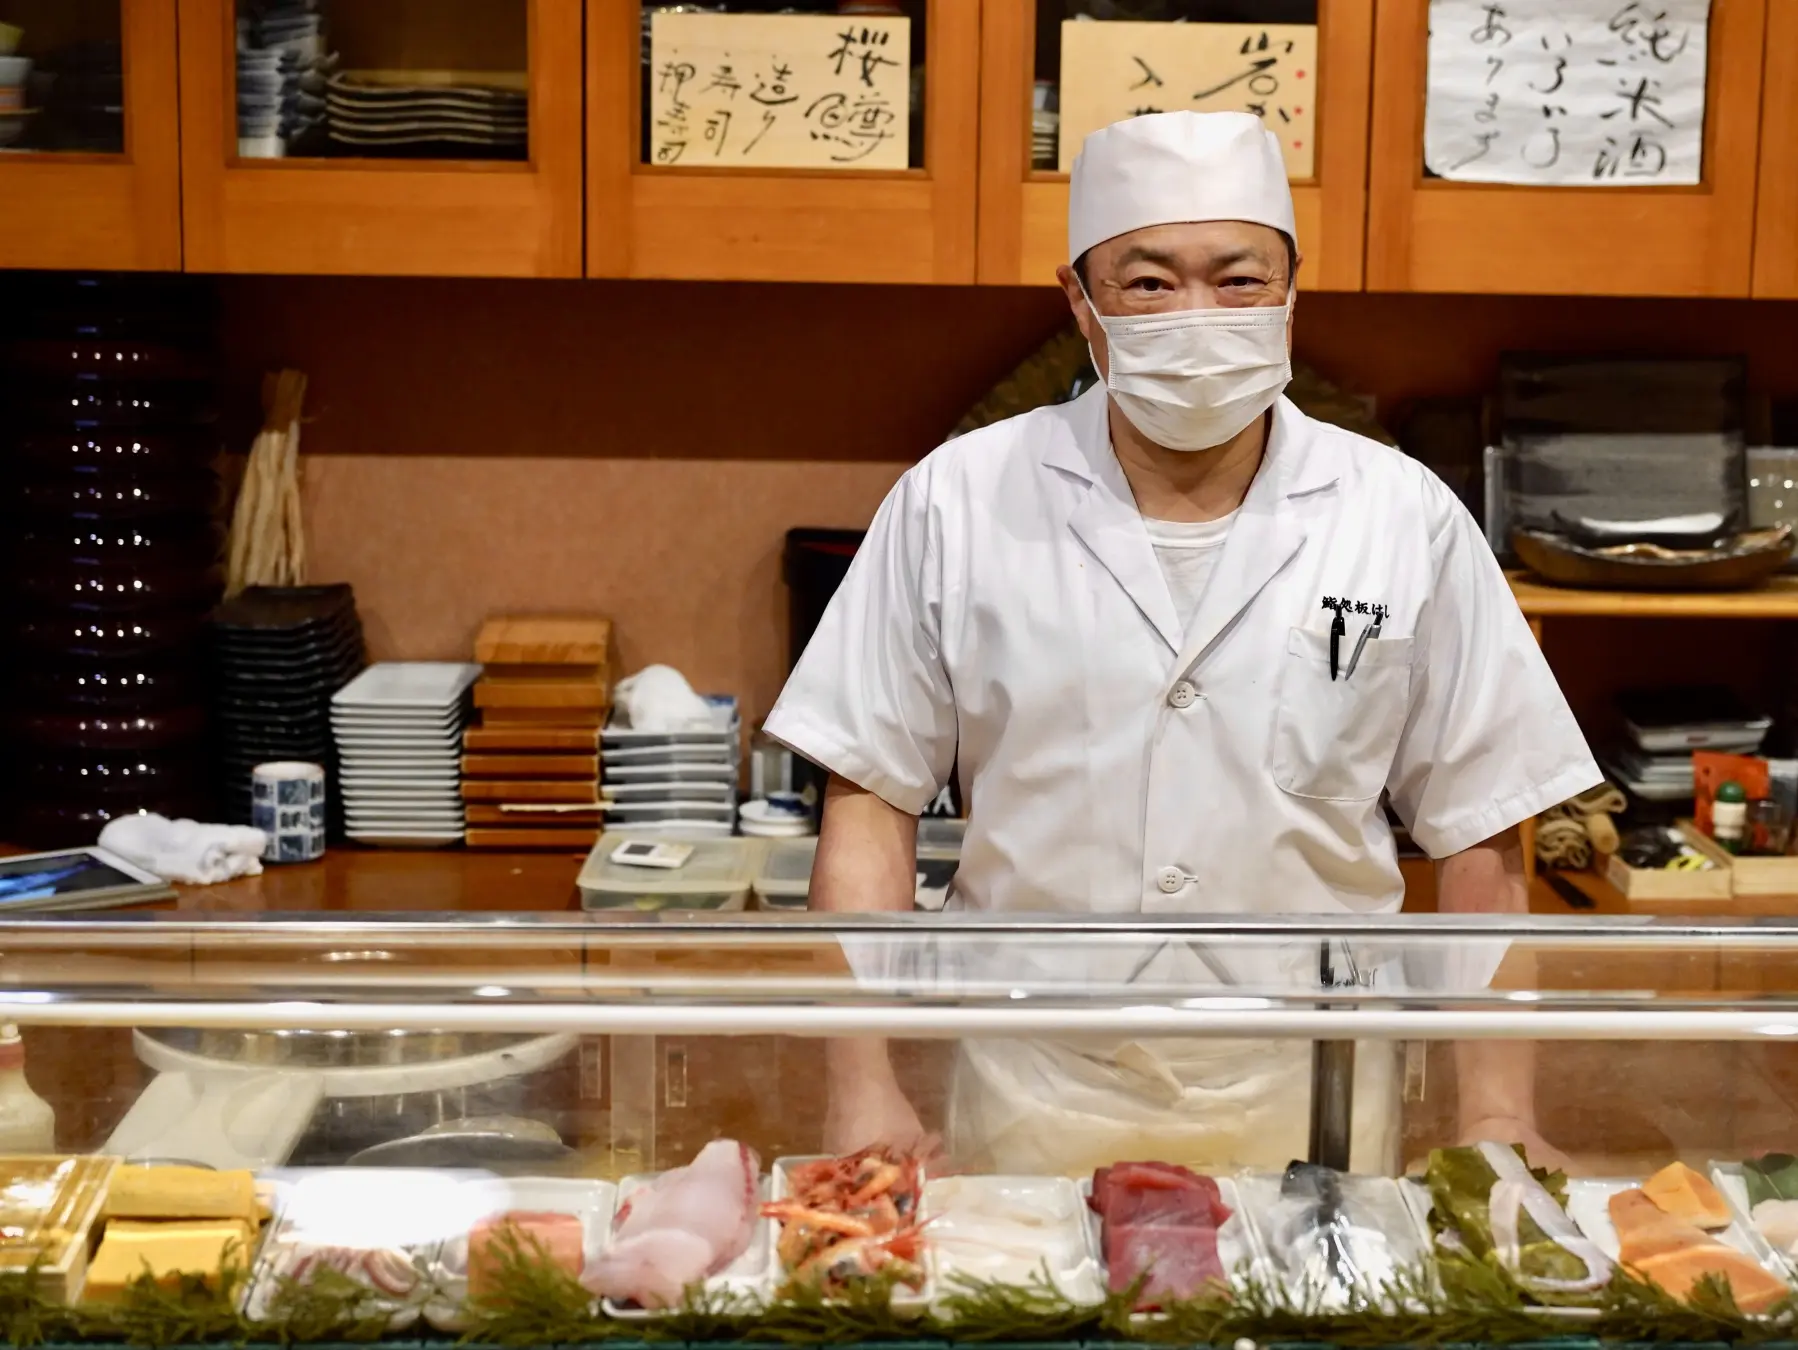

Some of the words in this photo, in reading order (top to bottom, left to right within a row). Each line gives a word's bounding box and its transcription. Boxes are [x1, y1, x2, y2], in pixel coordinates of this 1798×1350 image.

[1129, 56, 1163, 116] 入
[1450, 4, 1512, 171] あります
[1520, 33, 1573, 168] いろいろ
[1594, 2, 1690, 178] 純米酒
